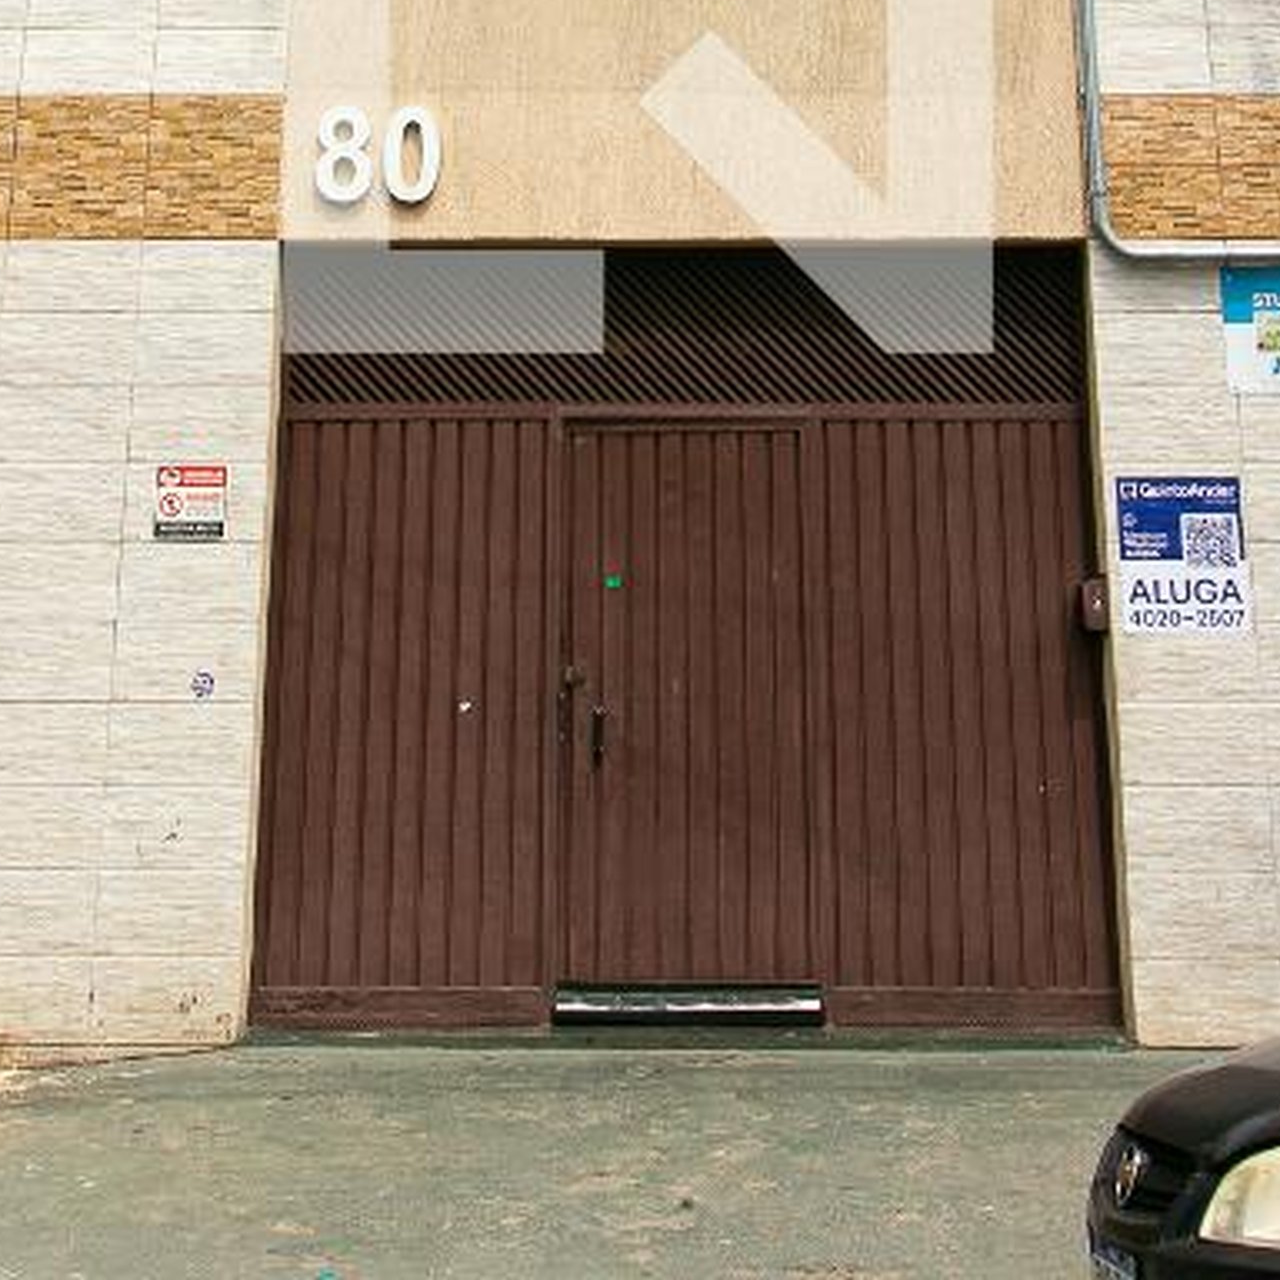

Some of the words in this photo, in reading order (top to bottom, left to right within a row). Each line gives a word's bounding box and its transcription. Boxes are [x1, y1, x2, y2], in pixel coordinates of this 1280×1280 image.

[316, 106, 441, 206] 80
[1129, 579, 1243, 605] ALUGA
[1130, 609, 1245, 627] 4020-2507
